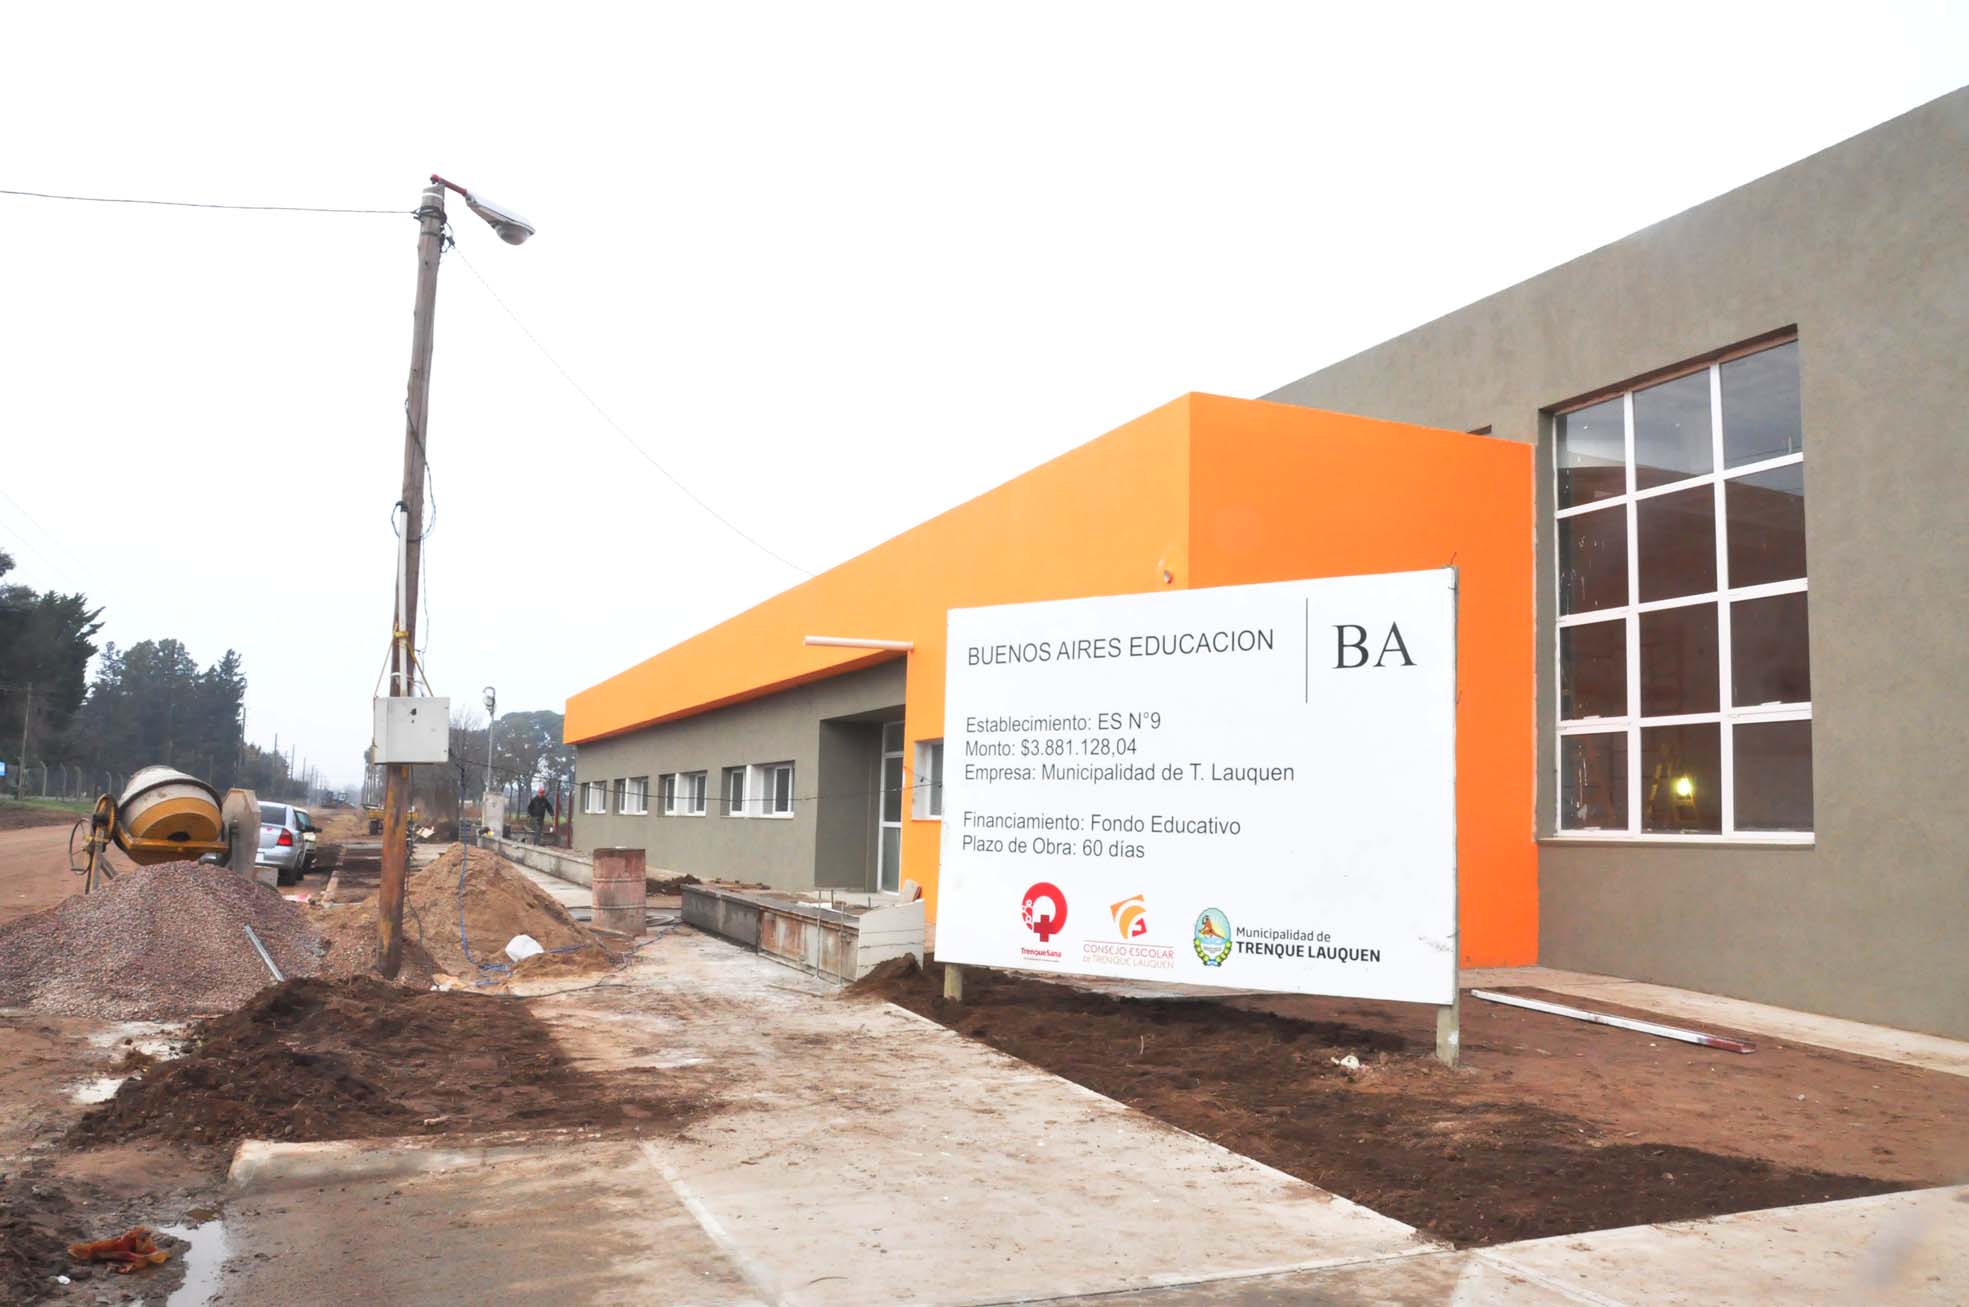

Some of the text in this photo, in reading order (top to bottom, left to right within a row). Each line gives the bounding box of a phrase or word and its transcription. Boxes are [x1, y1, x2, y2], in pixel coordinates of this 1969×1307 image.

[968, 629, 1273, 666] BUENOS AIRES EDUCACION
[1331, 621, 1418, 669] BA
[966, 714, 1092, 733] Establecimiento:
[1098, 712, 1122, 730] ES
[965, 738, 1137, 757] Monto: $3.881.128,04
[965, 763, 1295, 785] Empresa: Municipalidad de T. Lauquen
[963, 811, 1241, 835] Financiamiento: Fondo Educativo
[962, 835, 1003, 852] Plazo
[1008, 837, 1027, 853] de
[1032, 837, 1077, 855] Obra:
[1082, 839, 1103, 857] 60
[1236, 927, 1331, 942] Municipalidad de
[1083, 944, 1175, 959] CONSEJO ESCOLAR
[1236, 941, 1381, 963] TRENQUE LAUQUEN
